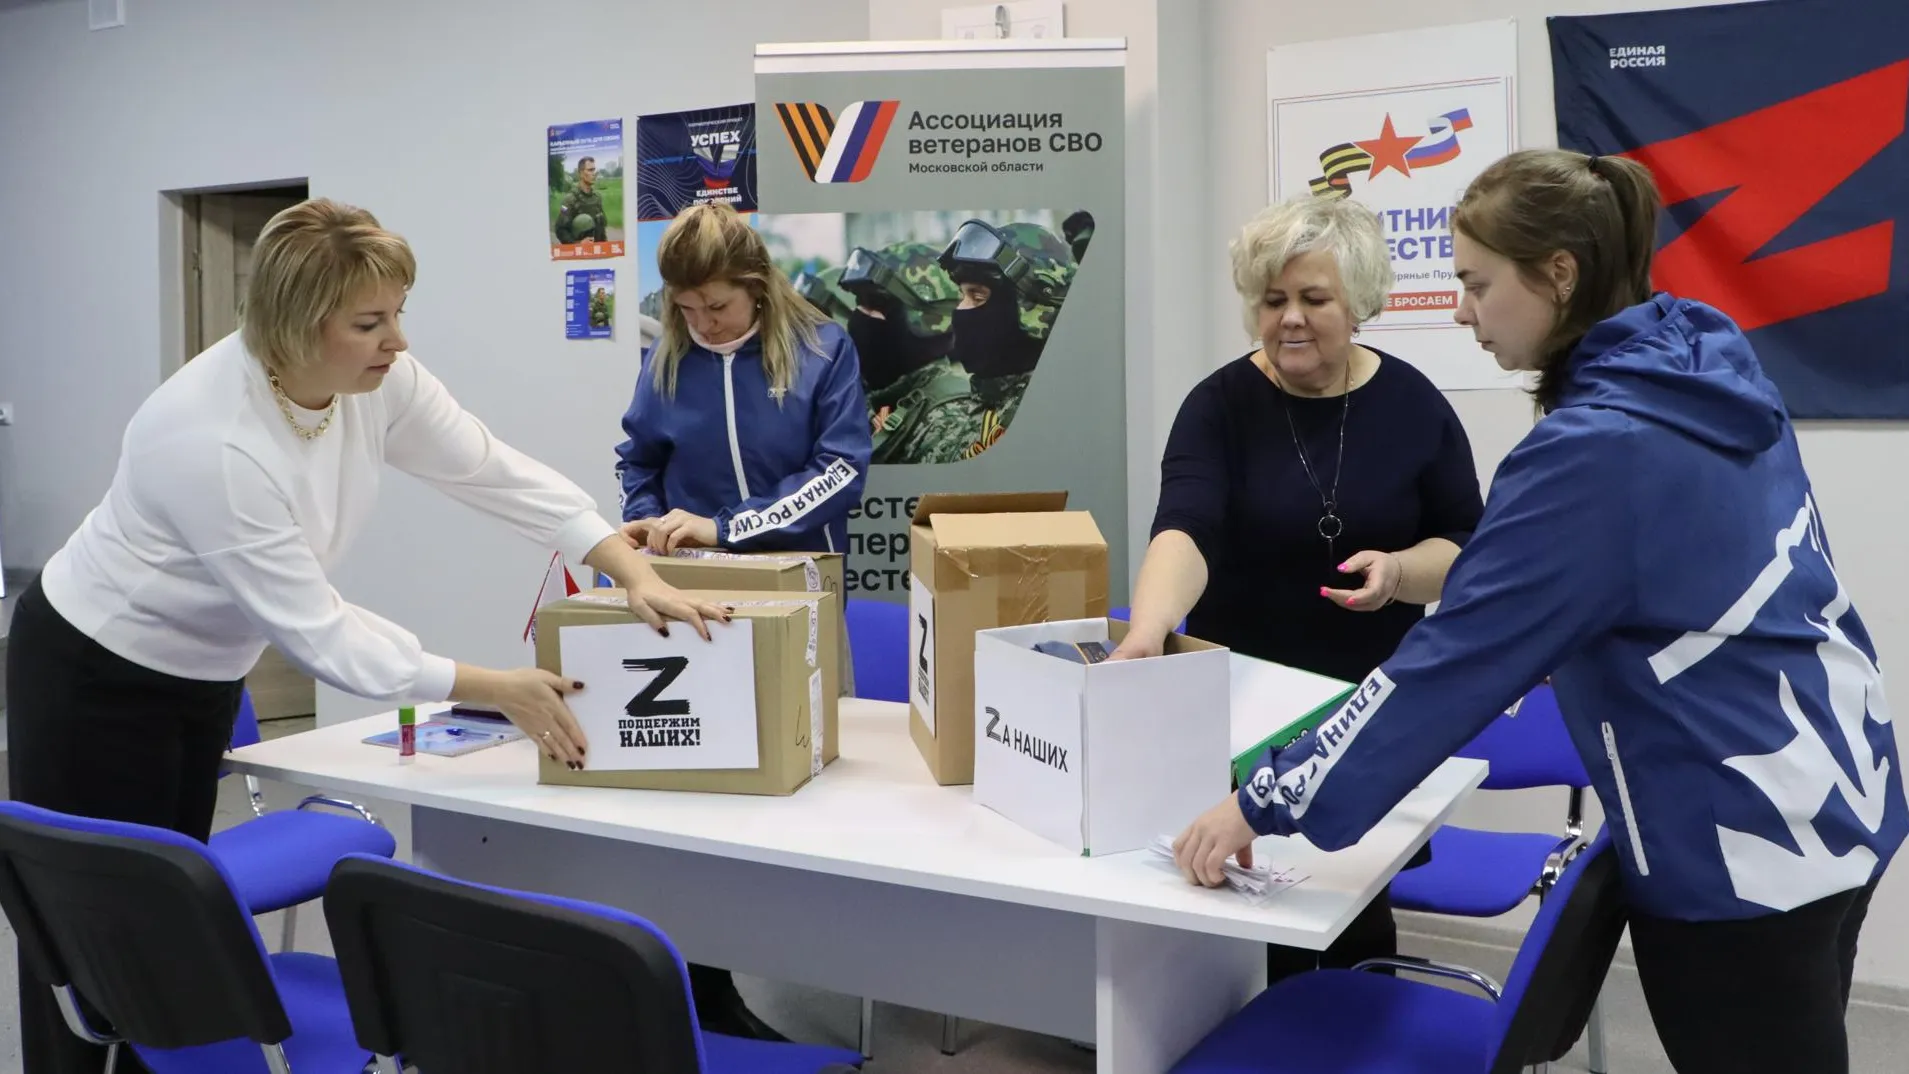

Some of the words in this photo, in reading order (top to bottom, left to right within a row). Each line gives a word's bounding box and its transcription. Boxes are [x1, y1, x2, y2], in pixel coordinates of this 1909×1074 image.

[1609, 45, 1666, 58] ЕДИНАЯ
[1610, 56, 1666, 69] РОССИЯ
[908, 110, 1063, 132] Ассоциация
[690, 130, 741, 147] УСПЕХ
[908, 137, 1042, 158] ветеранов
[1049, 132, 1103, 153] СВО
[909, 161, 988, 173] Московской
[990, 161, 1044, 173] области
[1395, 272, 1430, 283] ряные
[1394, 295, 1453, 308] БРОСАЕМ
[792, 463, 851, 512] ЕДИНАЯ
[734, 504, 793, 537] РОСИЯ
[621, 655, 691, 718] Z
[618, 717, 701, 730] ПОДДЕРЖИМ
[1309, 676, 1382, 780] ЕДИНА
[619, 728, 702, 748] НАШИХ!
[1013, 727, 1069, 774] НАШИХ
